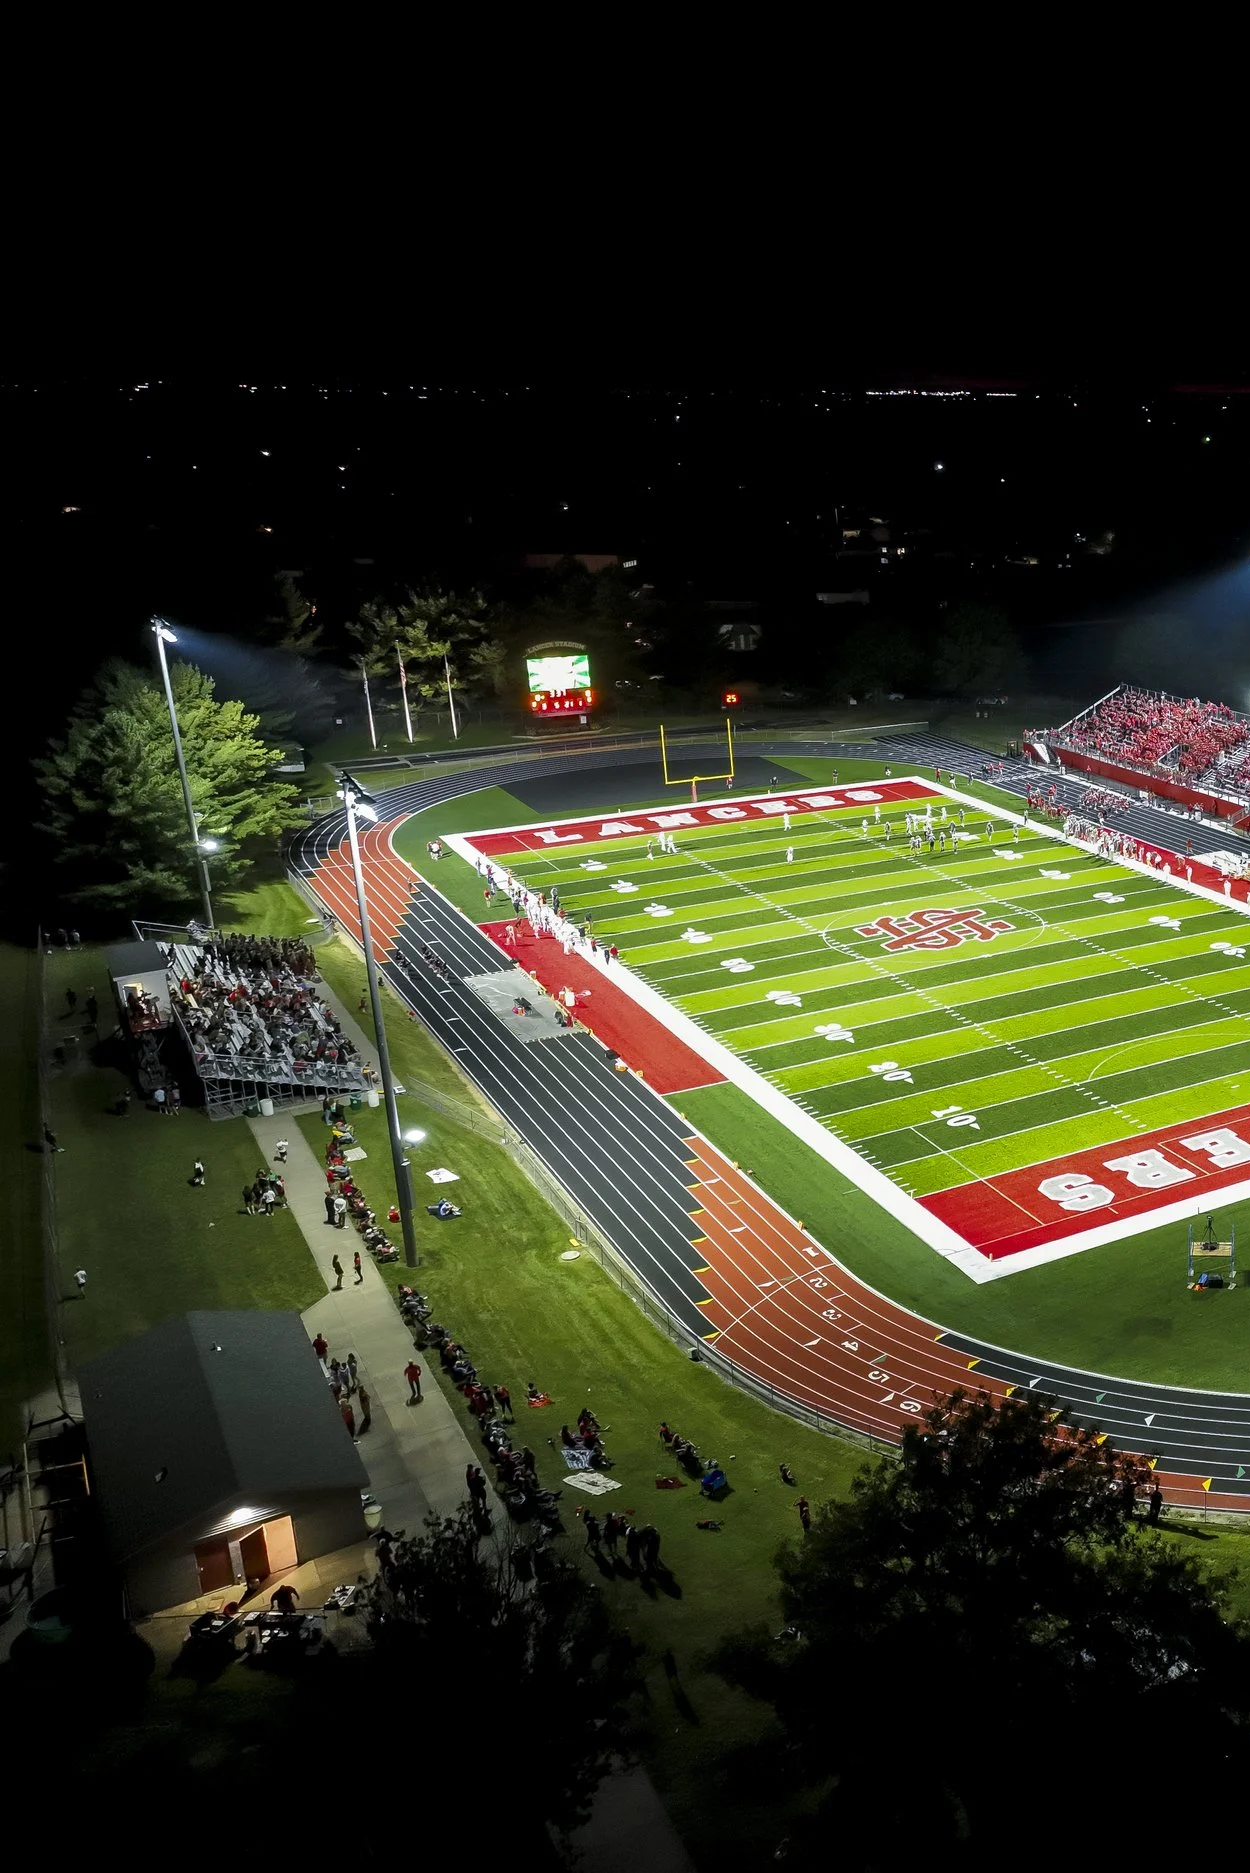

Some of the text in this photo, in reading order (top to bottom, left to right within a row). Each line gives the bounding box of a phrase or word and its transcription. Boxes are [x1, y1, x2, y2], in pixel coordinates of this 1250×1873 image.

[554, 641, 586, 650] STADIUM
[726, 694, 736, 703] 25
[533, 790, 885, 844] LANCERS
[930, 1105, 977, 1127] 10
[802, 1246, 819, 1258] 1
[809, 1277, 828, 1288] 2
[822, 1309, 842, 1320] 3
[841, 1340, 859, 1351] 4
[868, 1370, 890, 1383] 5
